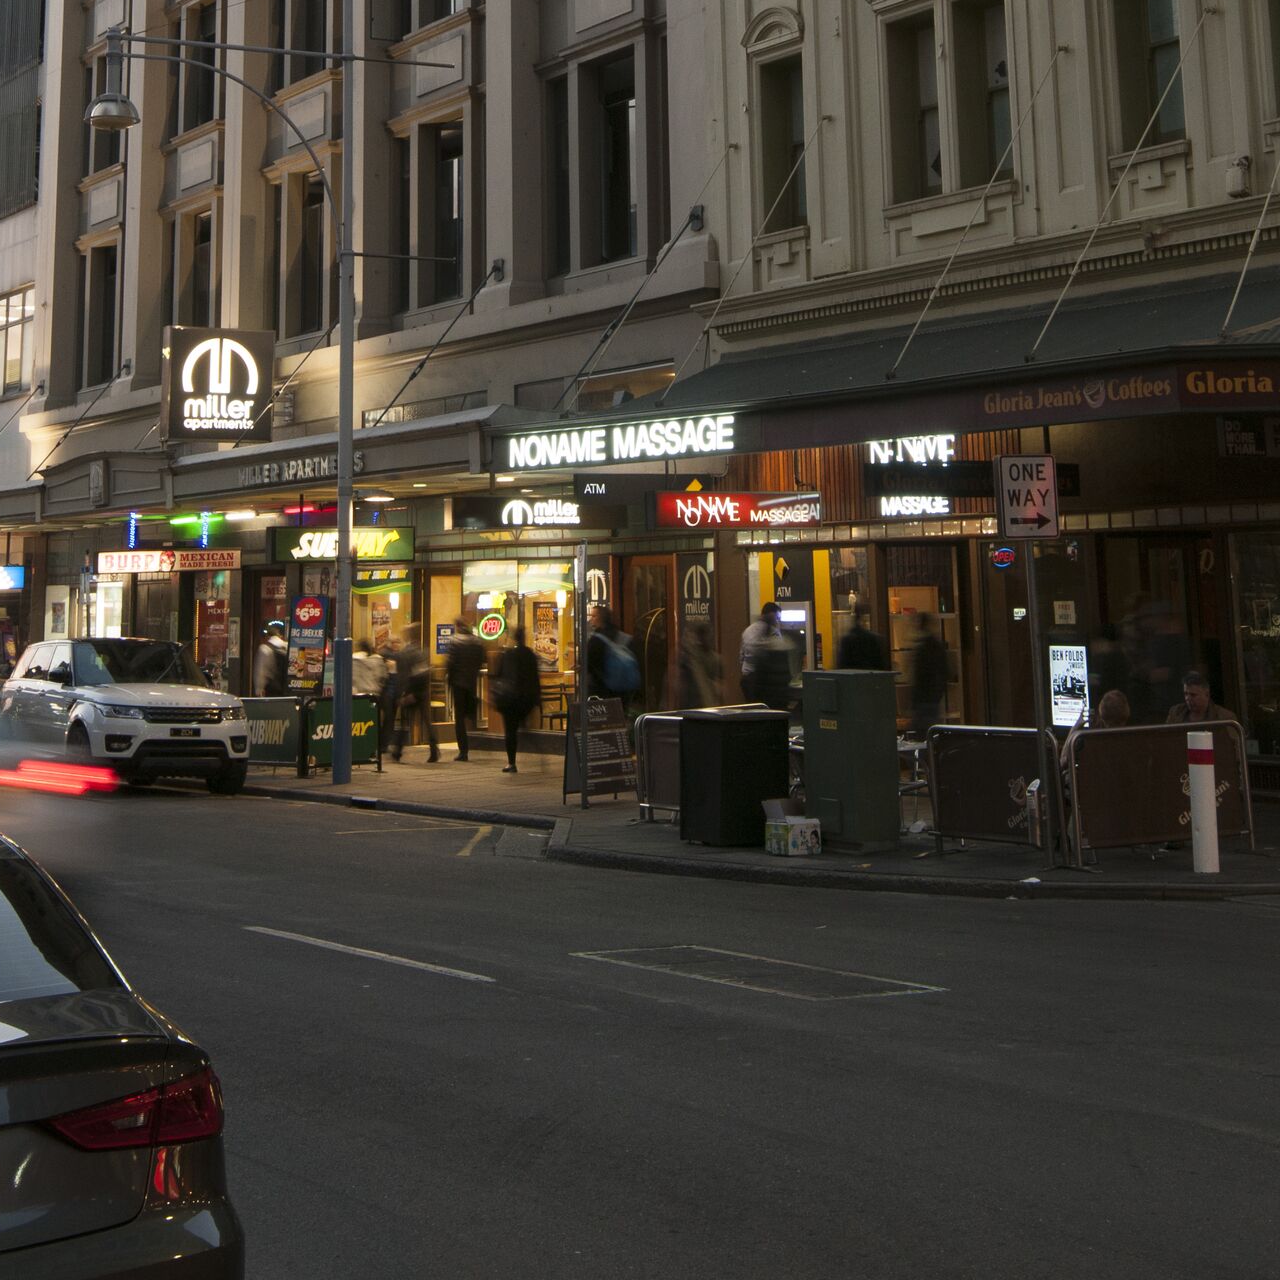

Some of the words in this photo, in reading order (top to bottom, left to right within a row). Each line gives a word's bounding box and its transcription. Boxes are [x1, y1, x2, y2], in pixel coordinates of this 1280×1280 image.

[1186, 370, 1273, 395] Gloria
[984, 390, 1033, 415] Gloria
[1036, 387, 1081, 409] Jean's
[1107, 378, 1170, 402] Coffees
[184, 395, 254, 419] miller
[183, 418, 254, 430] apartments
[509, 429, 606, 468] NONAME
[613, 416, 734, 459] MASSAGE
[282, 451, 365, 481] APARTMES
[1009, 463, 1047, 482] ONE
[584, 484, 605, 495] ATM
[1007, 489, 1049, 506] WAY
[534, 499, 579, 516] miller
[881, 497, 949, 516] MASSAGE
[750, 509, 809, 522] MASSAGE
[180, 552, 234, 562] MEXICAN
[205, 560, 234, 568] FRESH
[776, 586, 792, 597] ATM
[685, 601, 710, 614] miller
[482, 619, 501, 634] OPEN
[1052, 650, 1063, 661] BEN
[1064, 650, 1084, 662] FOLDS
[288, 679, 318, 688] SUBWAY
[248, 720, 289, 745] SUBWAY
